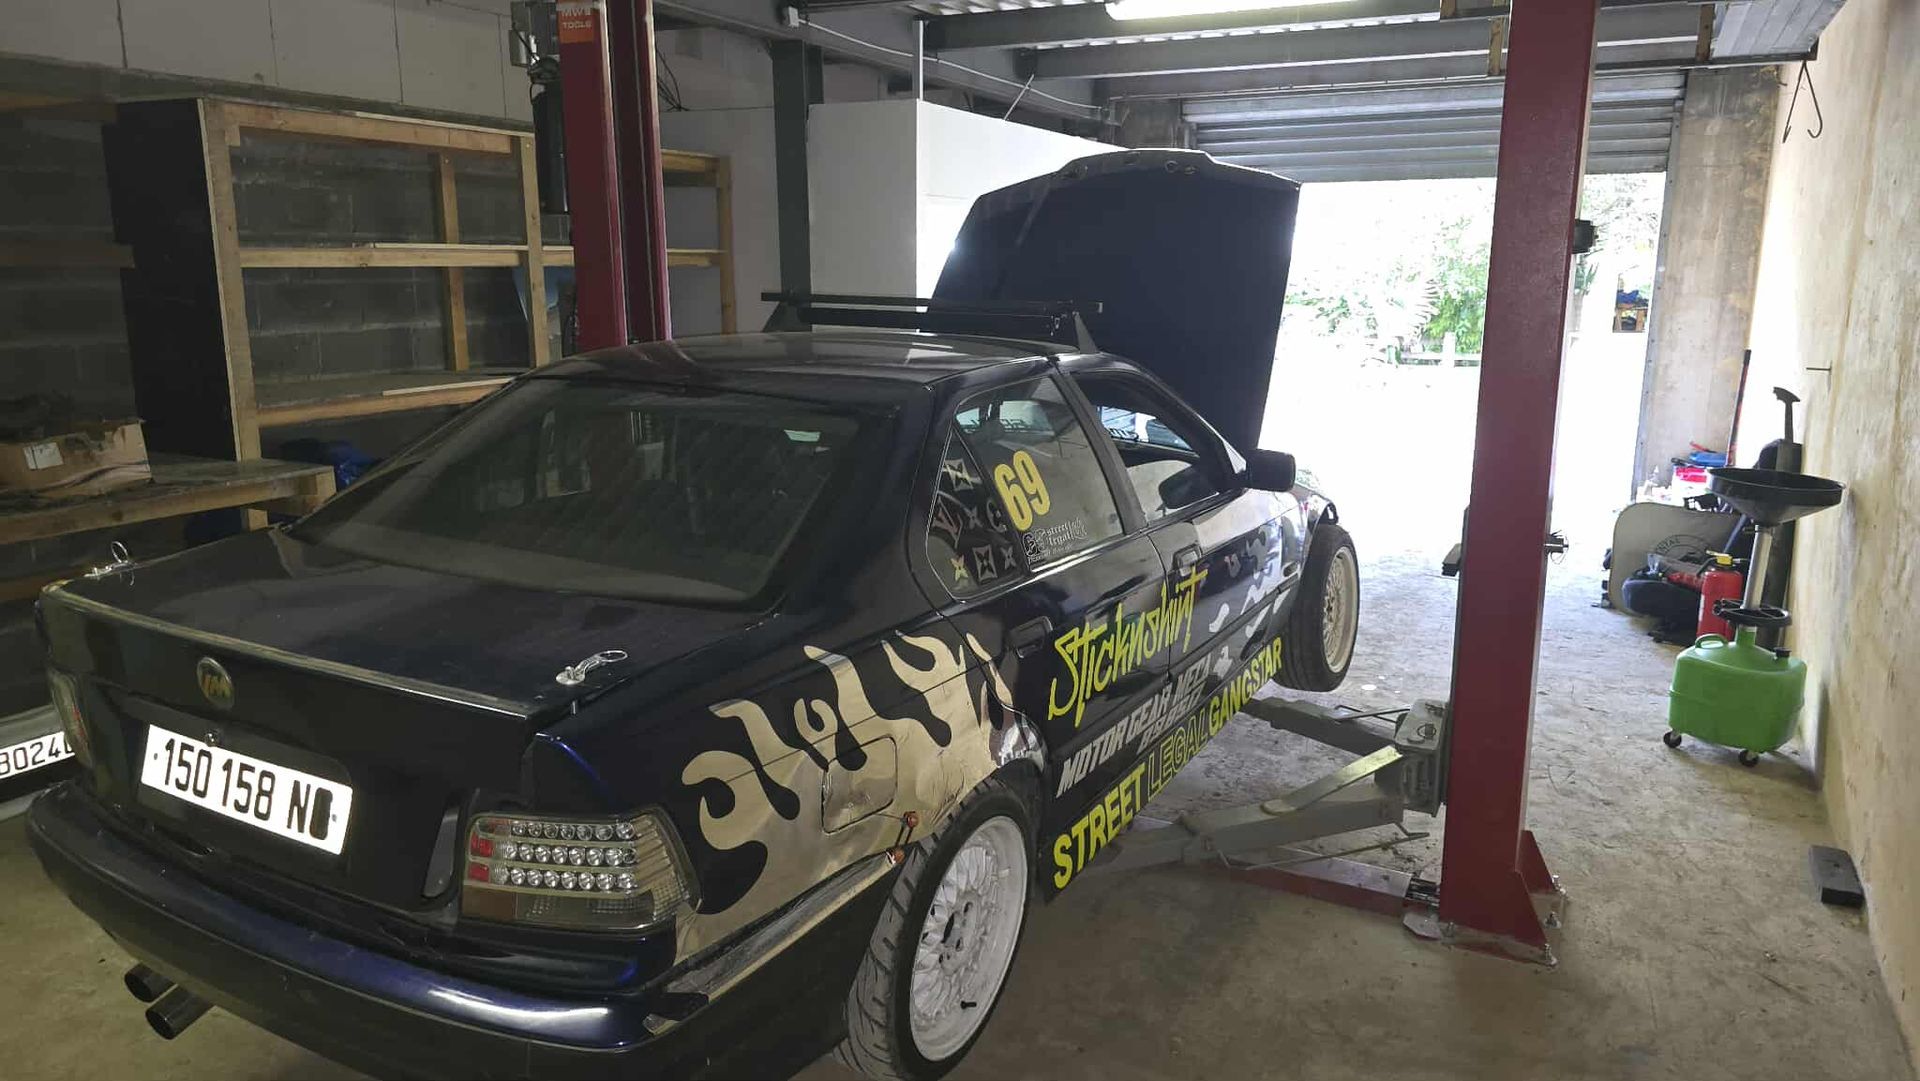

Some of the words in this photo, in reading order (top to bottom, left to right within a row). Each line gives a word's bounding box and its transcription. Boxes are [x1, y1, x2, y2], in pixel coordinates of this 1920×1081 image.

[994, 450, 1050, 531] 69
[165, 738, 213, 798] 150
[222, 758, 276, 821] 158
[1053, 761, 1145, 889] STREET
[1148, 706, 1208, 802] LEGAL
[1209, 636, 1282, 736] GANGSTAR
